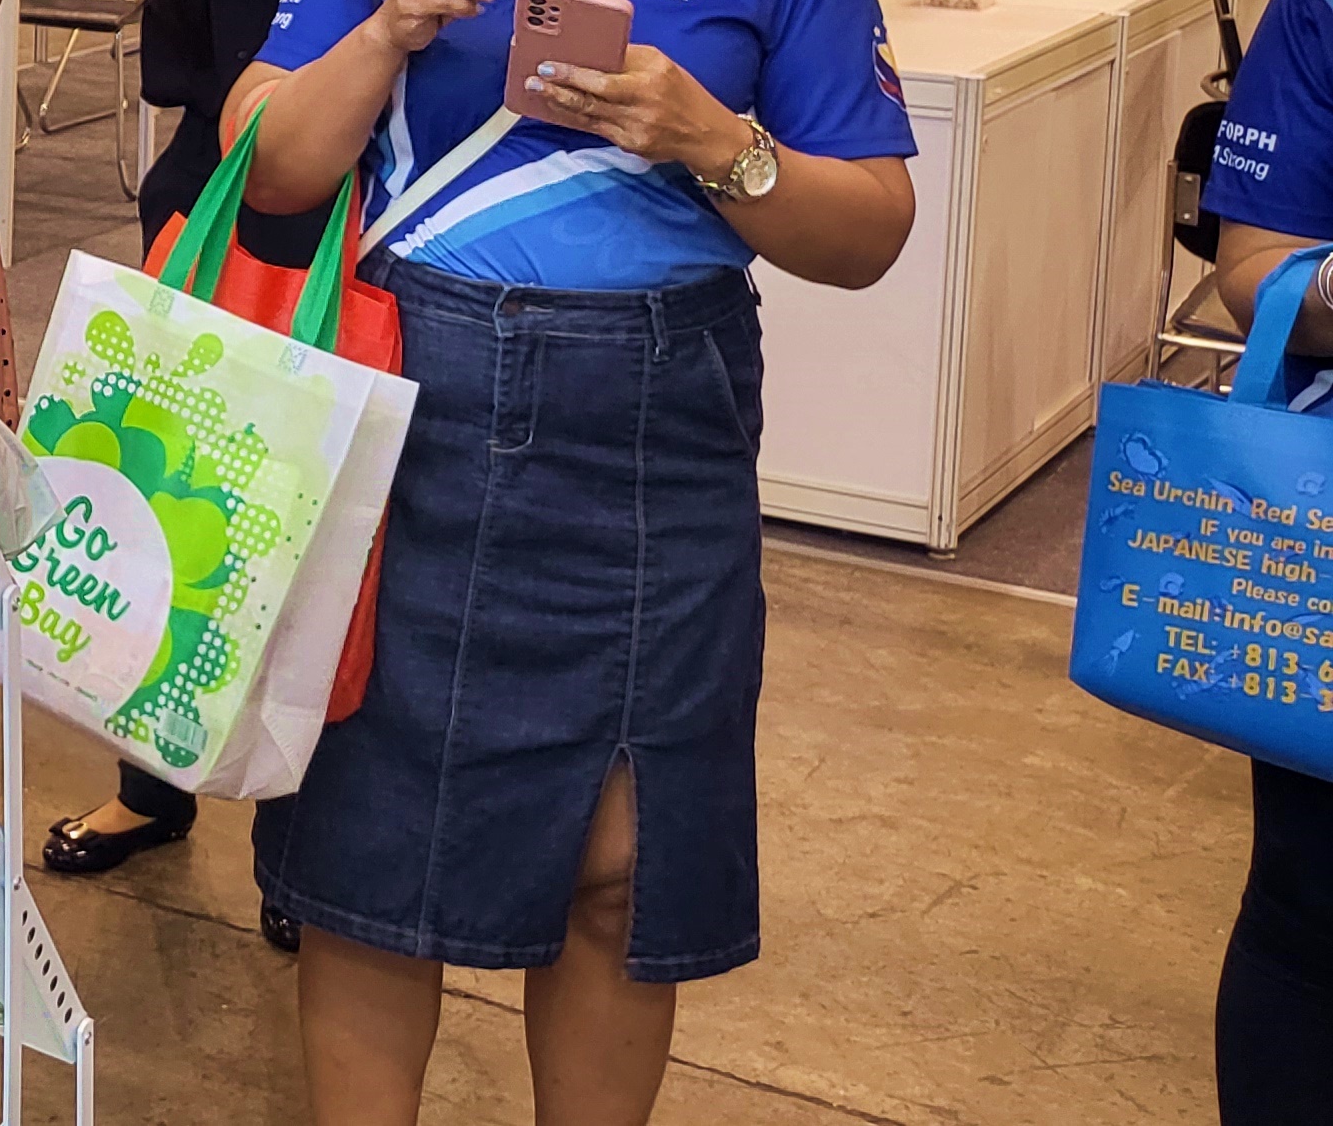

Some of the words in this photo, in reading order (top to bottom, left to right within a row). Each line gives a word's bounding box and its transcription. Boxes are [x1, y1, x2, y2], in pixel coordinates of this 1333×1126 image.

[1108, 471, 1145, 496] Sea
[1153, 480, 1233, 514] Urchin
[1250, 498, 1297, 525] Red
[56, 495, 118, 561] Go
[1200, 518, 1219, 536] IF
[1227, 527, 1264, 548] you
[1270, 534, 1307, 553] are
[1128, 528, 1251, 570] JAPANESE
[1231, 578, 1300, 605] Please
[18, 579, 92, 663] Bag
[1164, 626, 1217, 655] TEL:
[1157, 653, 1215, 682] FAX:
